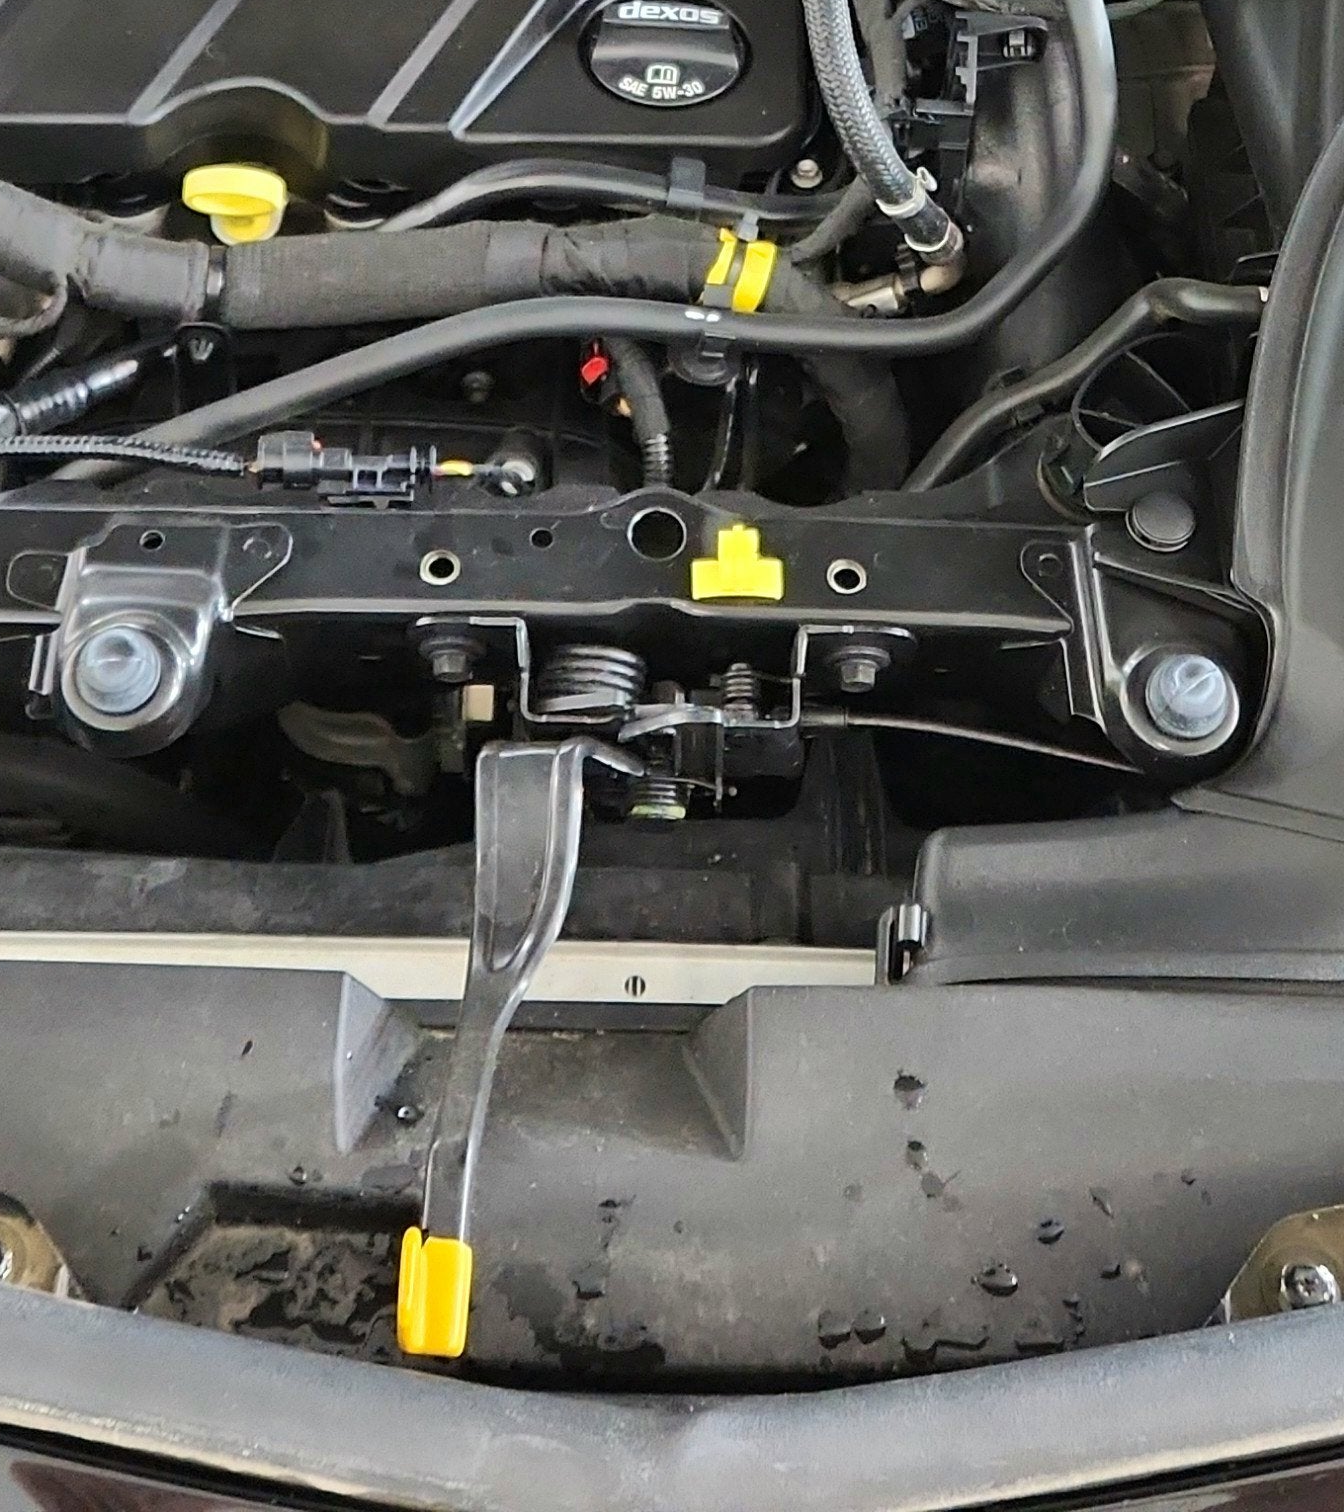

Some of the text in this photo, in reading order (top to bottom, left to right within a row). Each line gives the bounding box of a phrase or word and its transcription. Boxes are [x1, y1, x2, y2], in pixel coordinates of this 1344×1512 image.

[618, 0, 722, 24] dexos
[619, 77, 705, 100] SAE 5W-30
